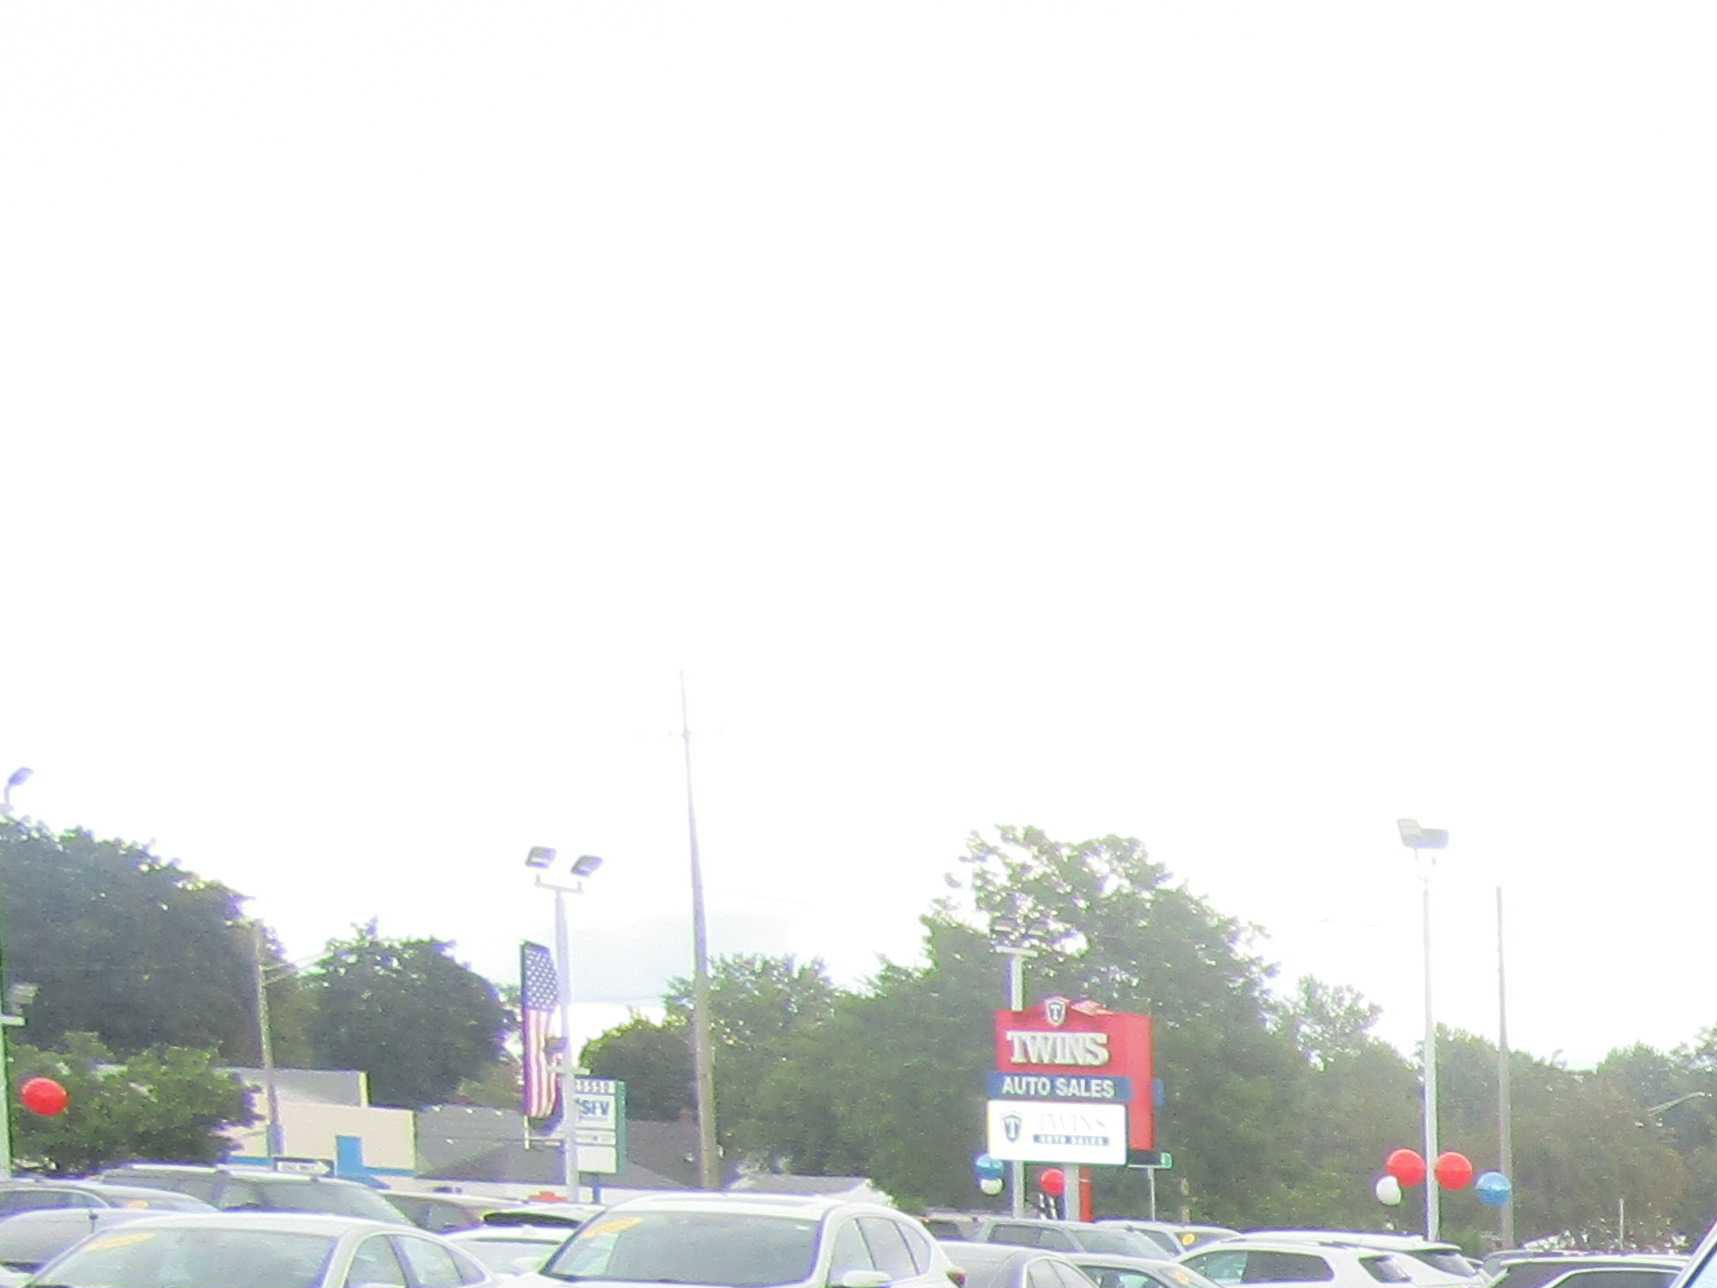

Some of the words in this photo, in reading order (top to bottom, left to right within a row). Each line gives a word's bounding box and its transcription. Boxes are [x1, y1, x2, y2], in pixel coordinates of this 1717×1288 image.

[1006, 1030, 1110, 1067] TWINS
[1002, 1076, 1050, 1096] AUTO
[1055, 1078, 1115, 1099] SALES
